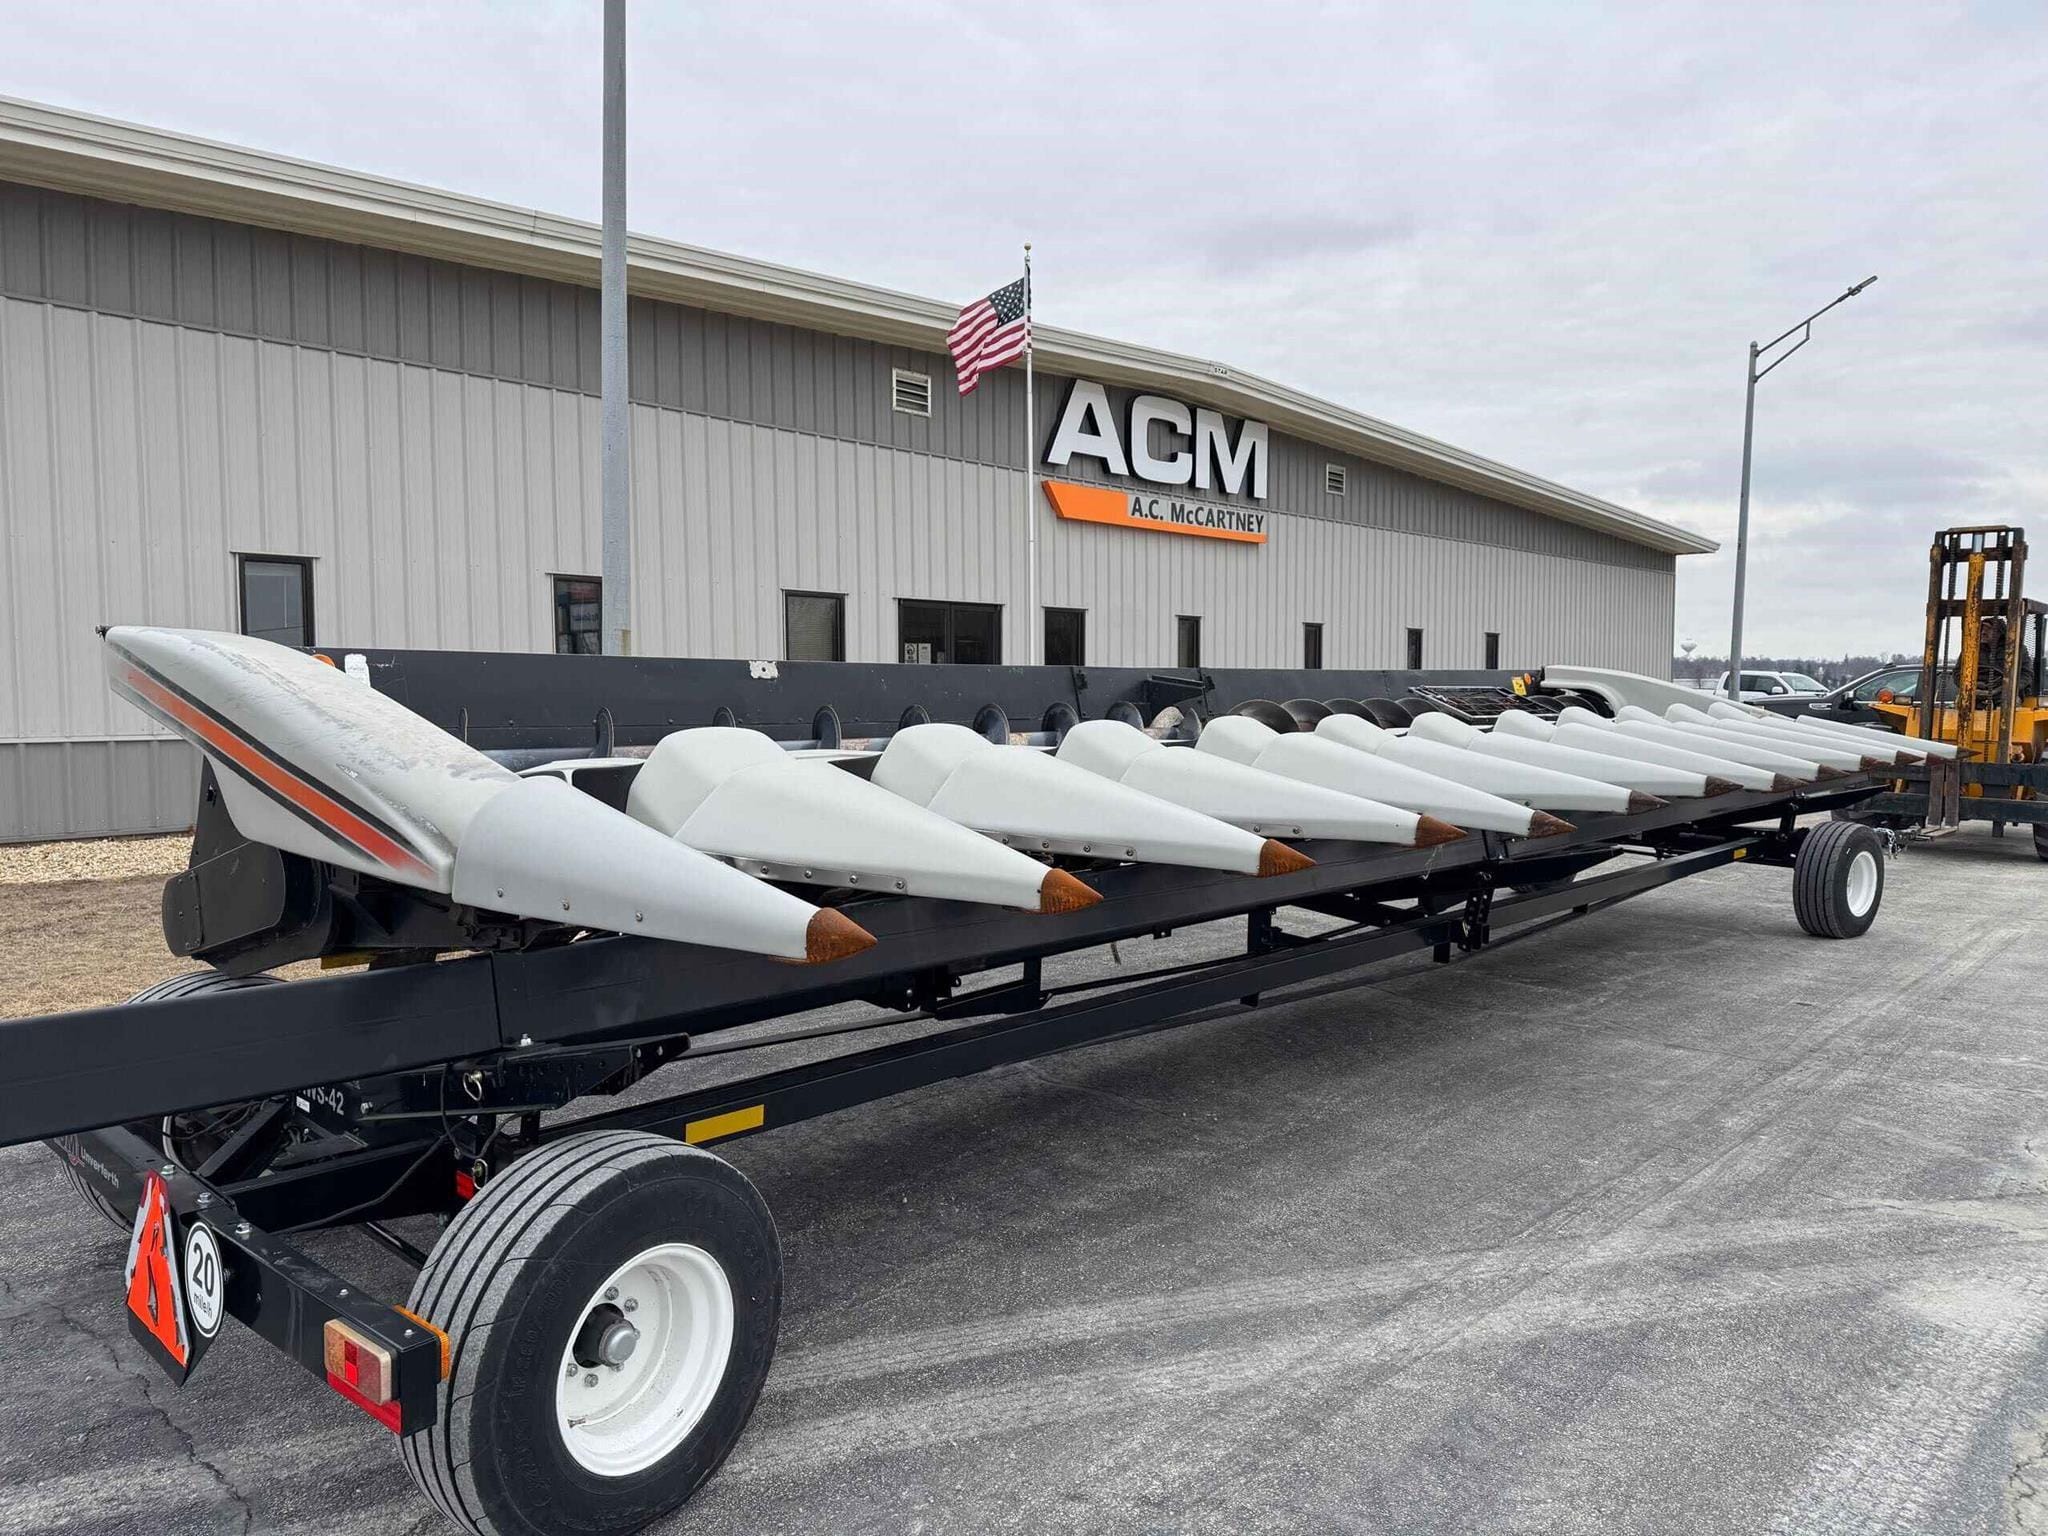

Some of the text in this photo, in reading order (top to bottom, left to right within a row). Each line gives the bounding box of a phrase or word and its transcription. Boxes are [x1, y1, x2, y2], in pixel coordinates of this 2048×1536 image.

[1047, 379, 1268, 499] ACM
[1131, 497, 1264, 532] A.C. McCARTNEY
[192, 1242, 215, 1297] 20
